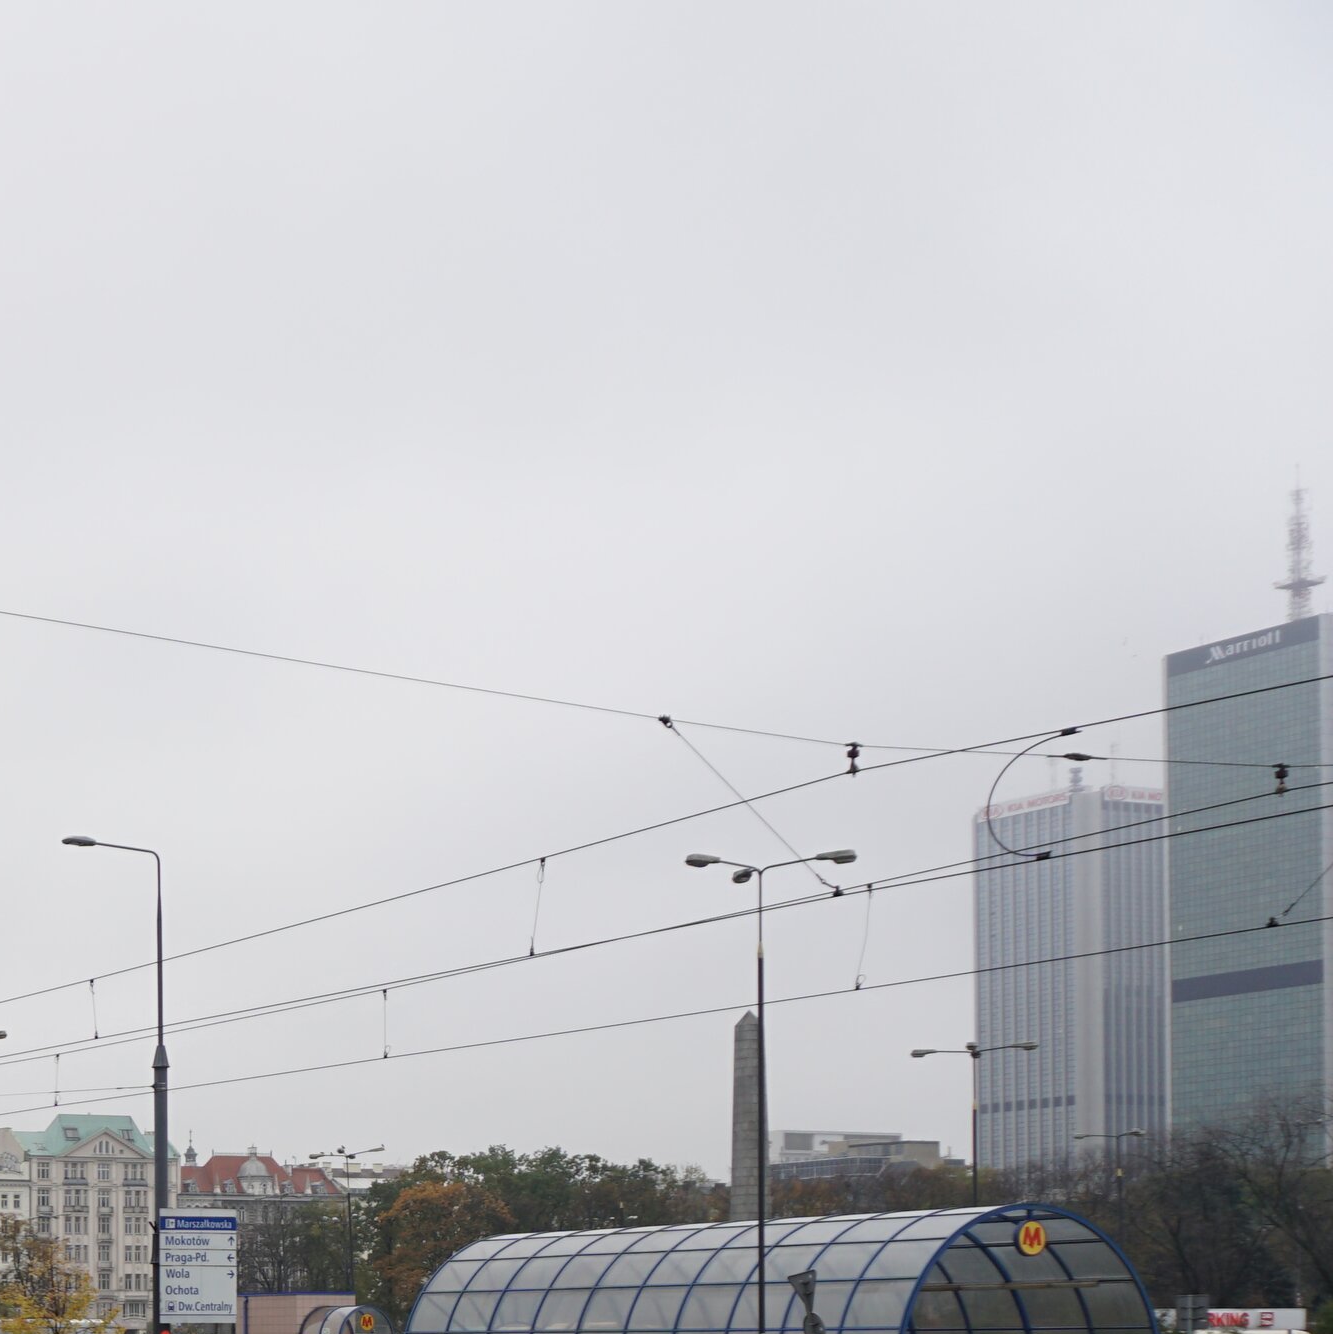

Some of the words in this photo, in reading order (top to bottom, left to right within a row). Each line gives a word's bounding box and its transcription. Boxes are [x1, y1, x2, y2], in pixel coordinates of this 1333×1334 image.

[1204, 629, 1281, 664] Marriott
[176, 1219, 233, 1229] Marszałkowska
[165, 1235, 210, 1246] Mokotów
[165, 1252, 210, 1264] Praga-Pd.
[165, 1268, 191, 1279] Wola
[165, 1285, 199, 1296] Ochota
[1206, 1311, 1250, 1328] RKING
